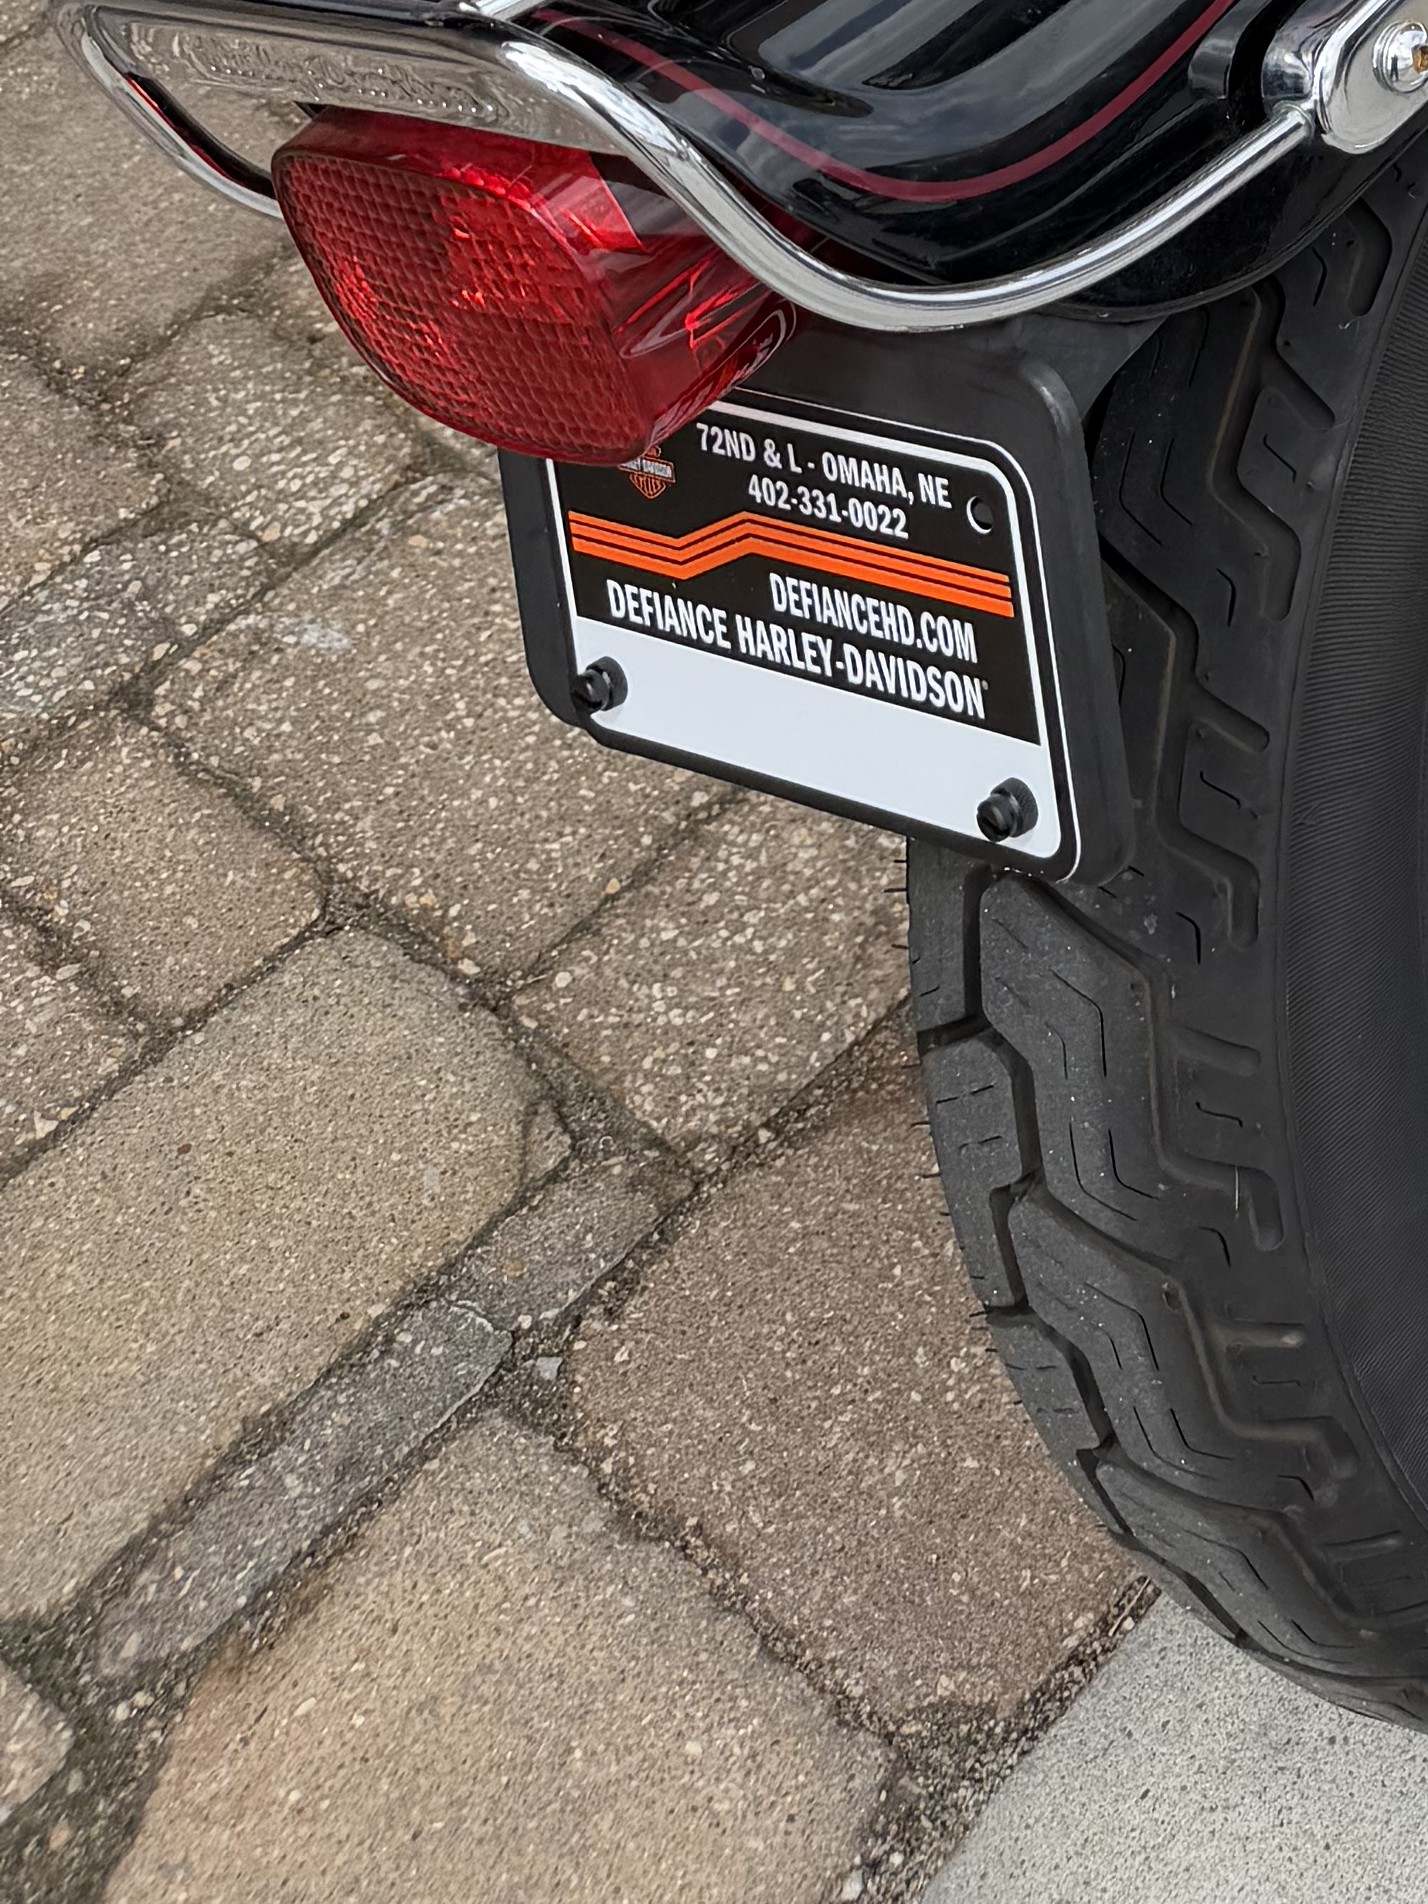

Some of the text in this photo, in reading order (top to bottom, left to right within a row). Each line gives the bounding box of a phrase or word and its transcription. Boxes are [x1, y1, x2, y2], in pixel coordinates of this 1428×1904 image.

[696, 422, 756, 462] 72ND
[763, 438, 782, 469] &
[787, 443, 802, 474] L
[822, 451, 914, 505] OMAHA,
[918, 472, 952, 509] NE
[748, 474, 909, 539] 402-331-0022
[606, 578, 731, 650] DEFIANCE
[768, 572, 979, 664] DEFIANCEHD.COM
